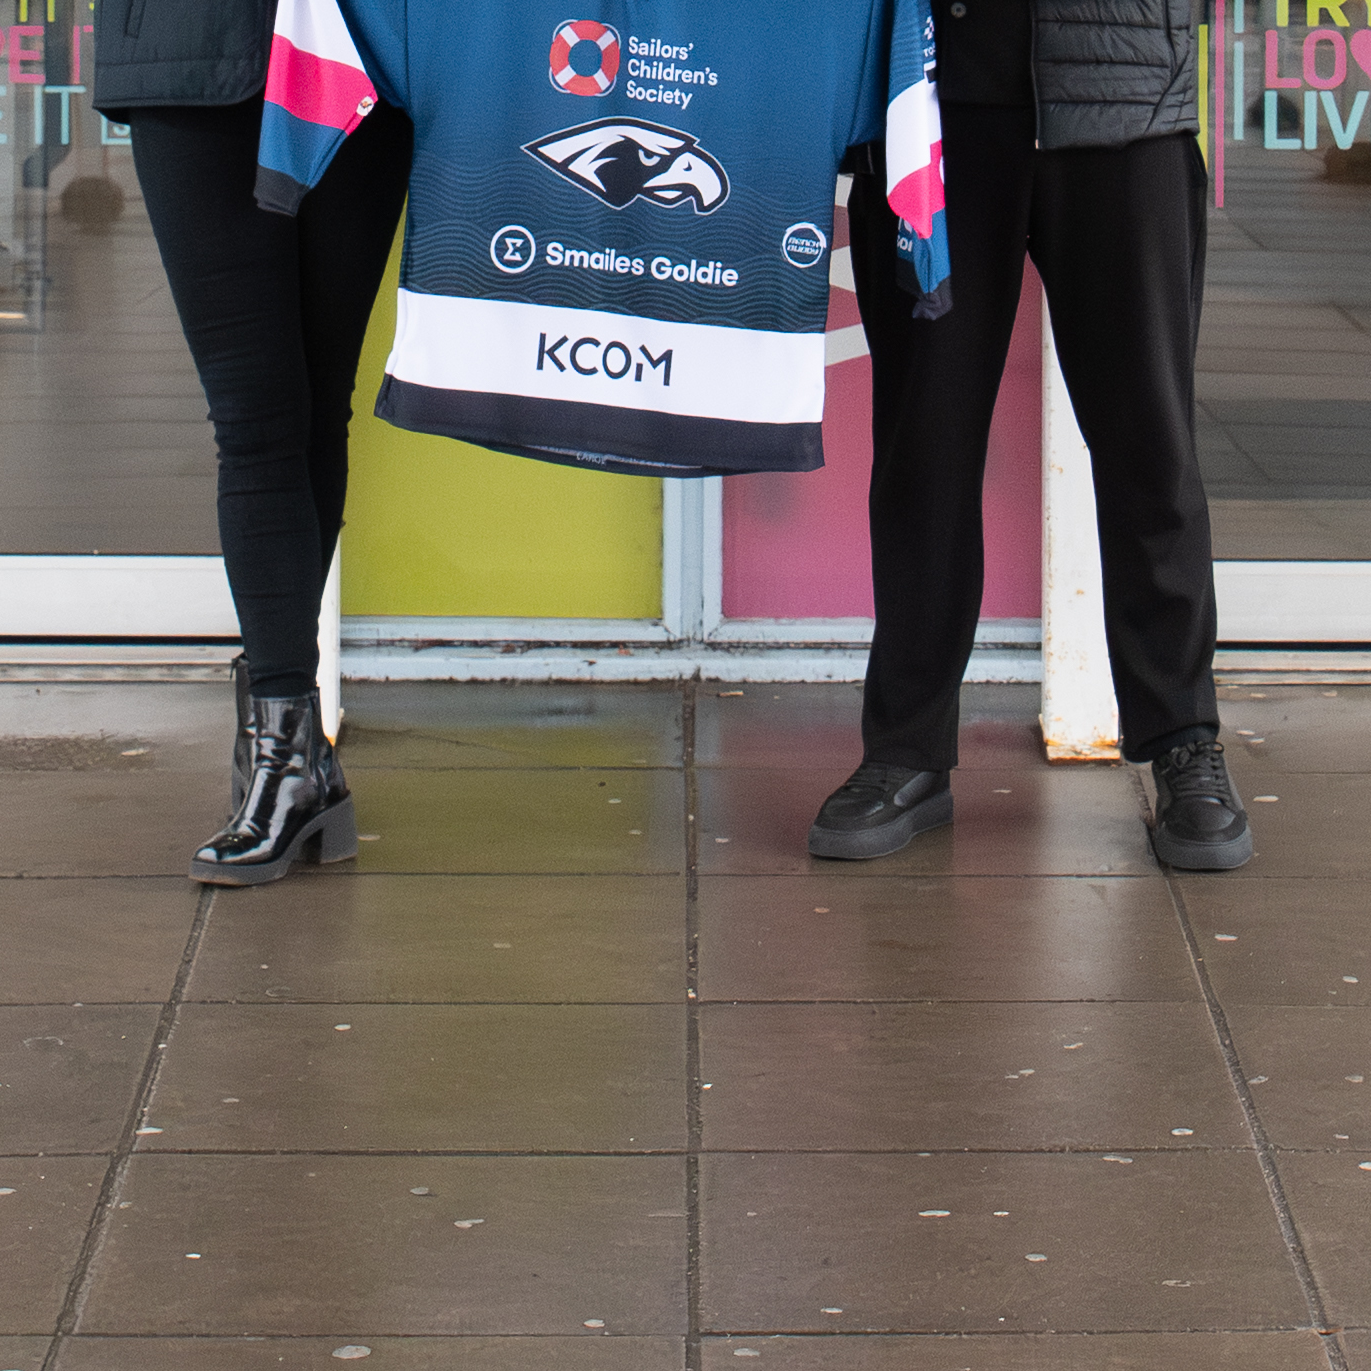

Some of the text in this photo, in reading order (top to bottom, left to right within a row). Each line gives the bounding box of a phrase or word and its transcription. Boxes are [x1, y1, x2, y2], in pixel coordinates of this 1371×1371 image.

[73, 25, 94, 84] I
[33, 85, 87, 145] IT
[626, 79, 693, 110] Society
[545, 241, 739, 287] Smailes Goldie
[536, 332, 673, 387] KCOM
